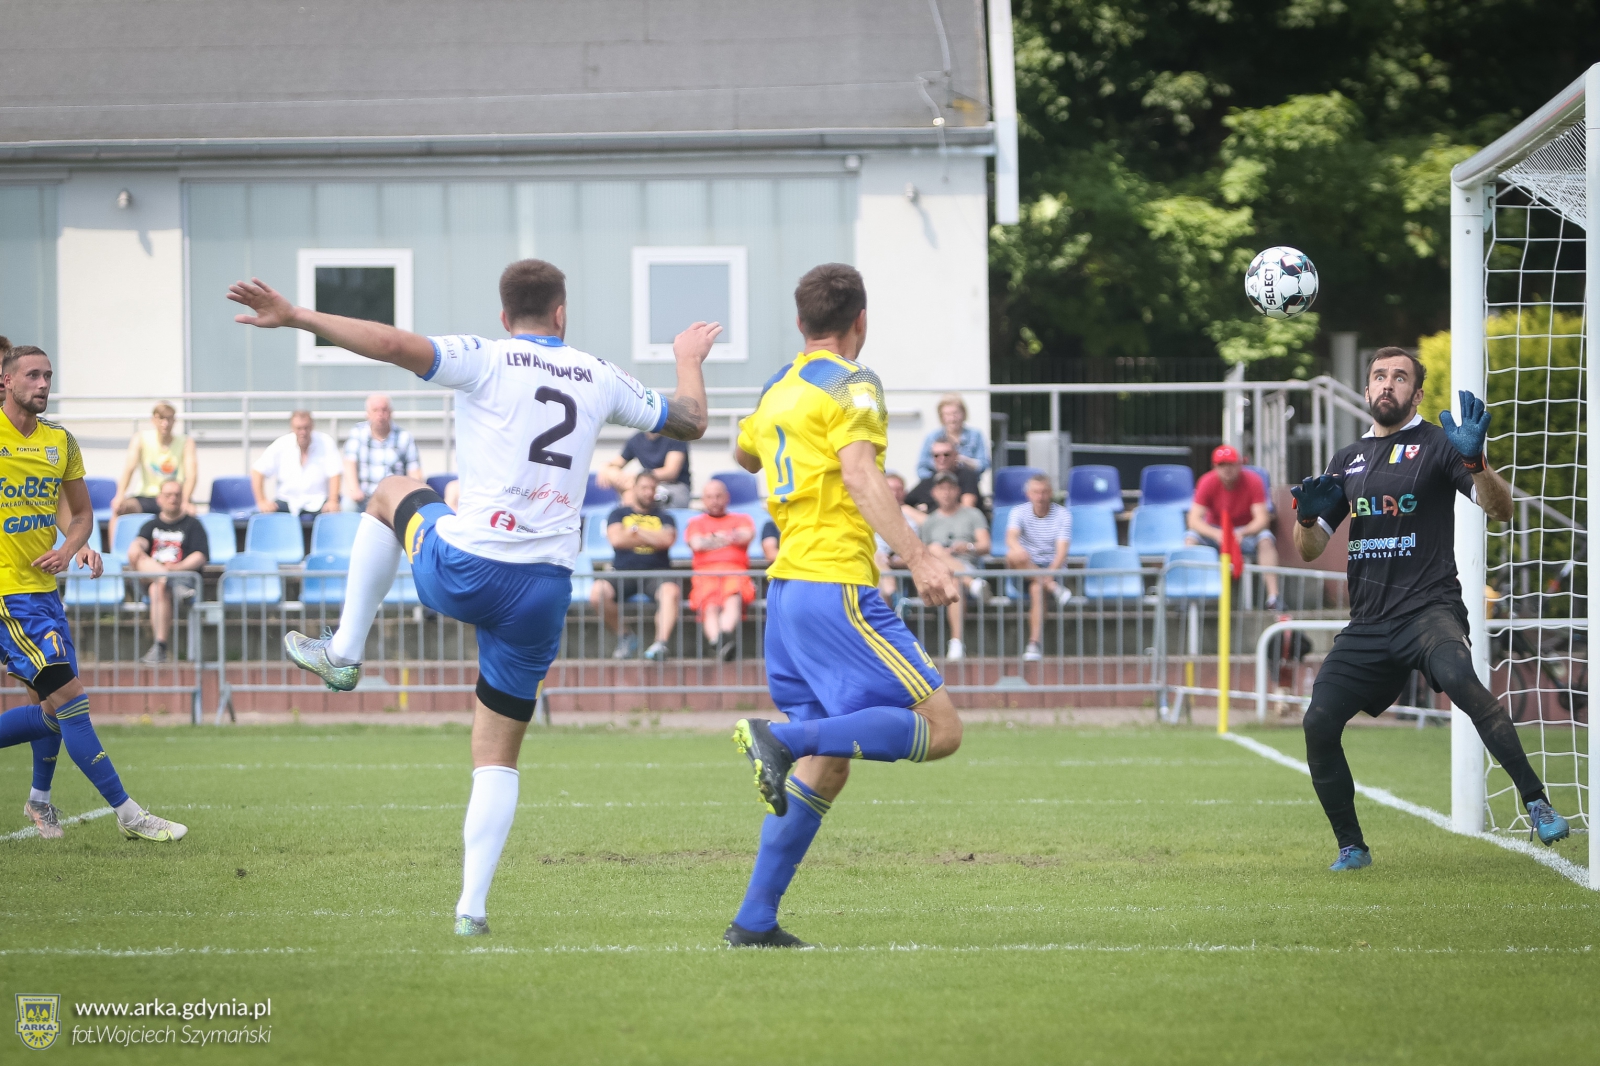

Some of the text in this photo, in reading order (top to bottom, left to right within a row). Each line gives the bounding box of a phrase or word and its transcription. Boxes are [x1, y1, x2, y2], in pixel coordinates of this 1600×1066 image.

[1265, 268, 1276, 305] SELECT
[528, 385, 578, 471] 2
[502, 486, 530, 497] MEBLE
[1348, 550, 1412, 560] OTOWOLTAIKA
